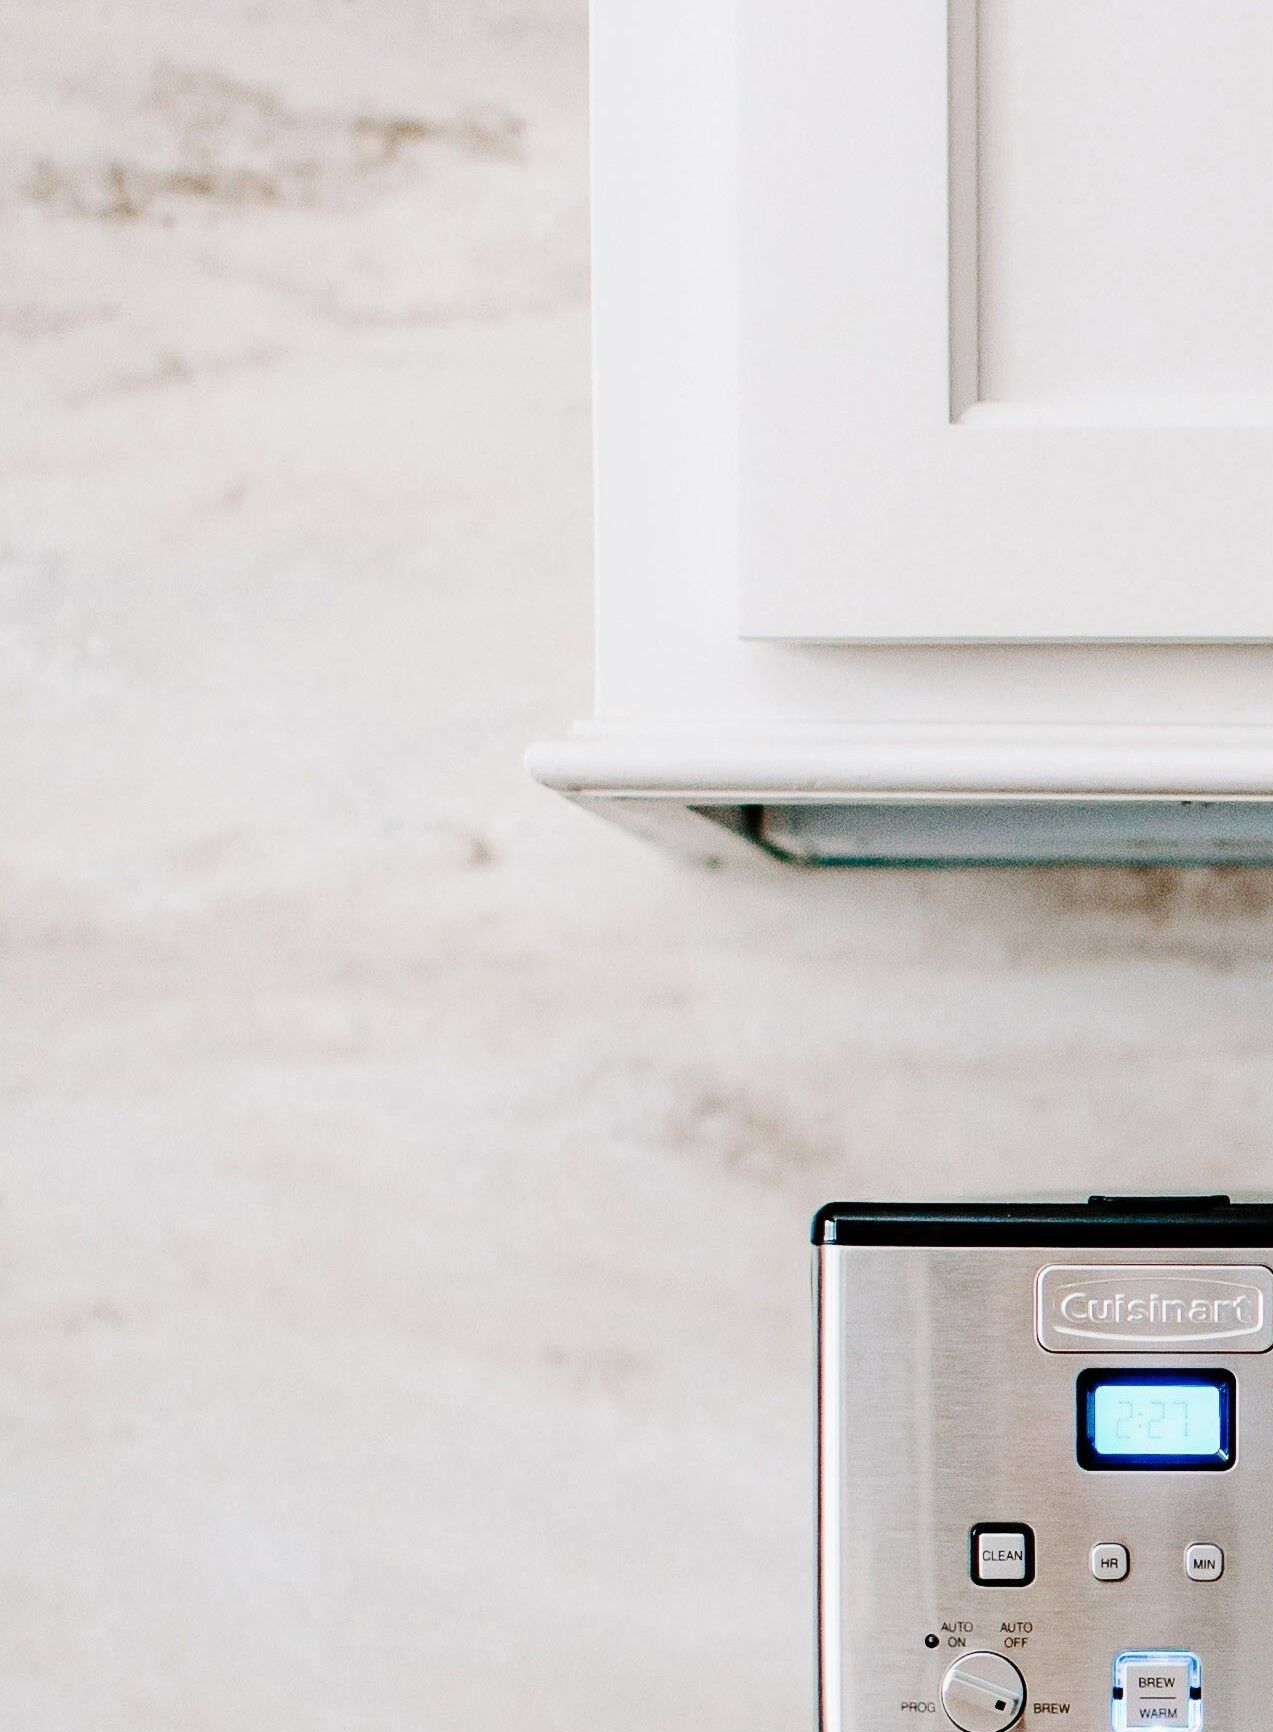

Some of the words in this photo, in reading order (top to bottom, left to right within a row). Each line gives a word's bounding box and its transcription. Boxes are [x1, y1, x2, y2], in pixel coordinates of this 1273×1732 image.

[1060, 1292, 1251, 1324] Cuisinart
[1115, 1400, 1189, 1439] 2:27
[981, 1550, 1023, 1562] CLEAN
[1100, 1558, 1119, 1569] HR
[1193, 1558, 1216, 1570] MIN
[941, 1621, 974, 1633] AUTO
[1000, 1621, 1033, 1634] AUTO
[947, 1636, 967, 1648] ON
[1004, 1636, 1029, 1648] OFF
[1138, 1677, 1176, 1688] BREW
[901, 1701, 936, 1713] PROG
[1033, 1702, 1071, 1714] BREW
[1139, 1708, 1178, 1719] WARM
